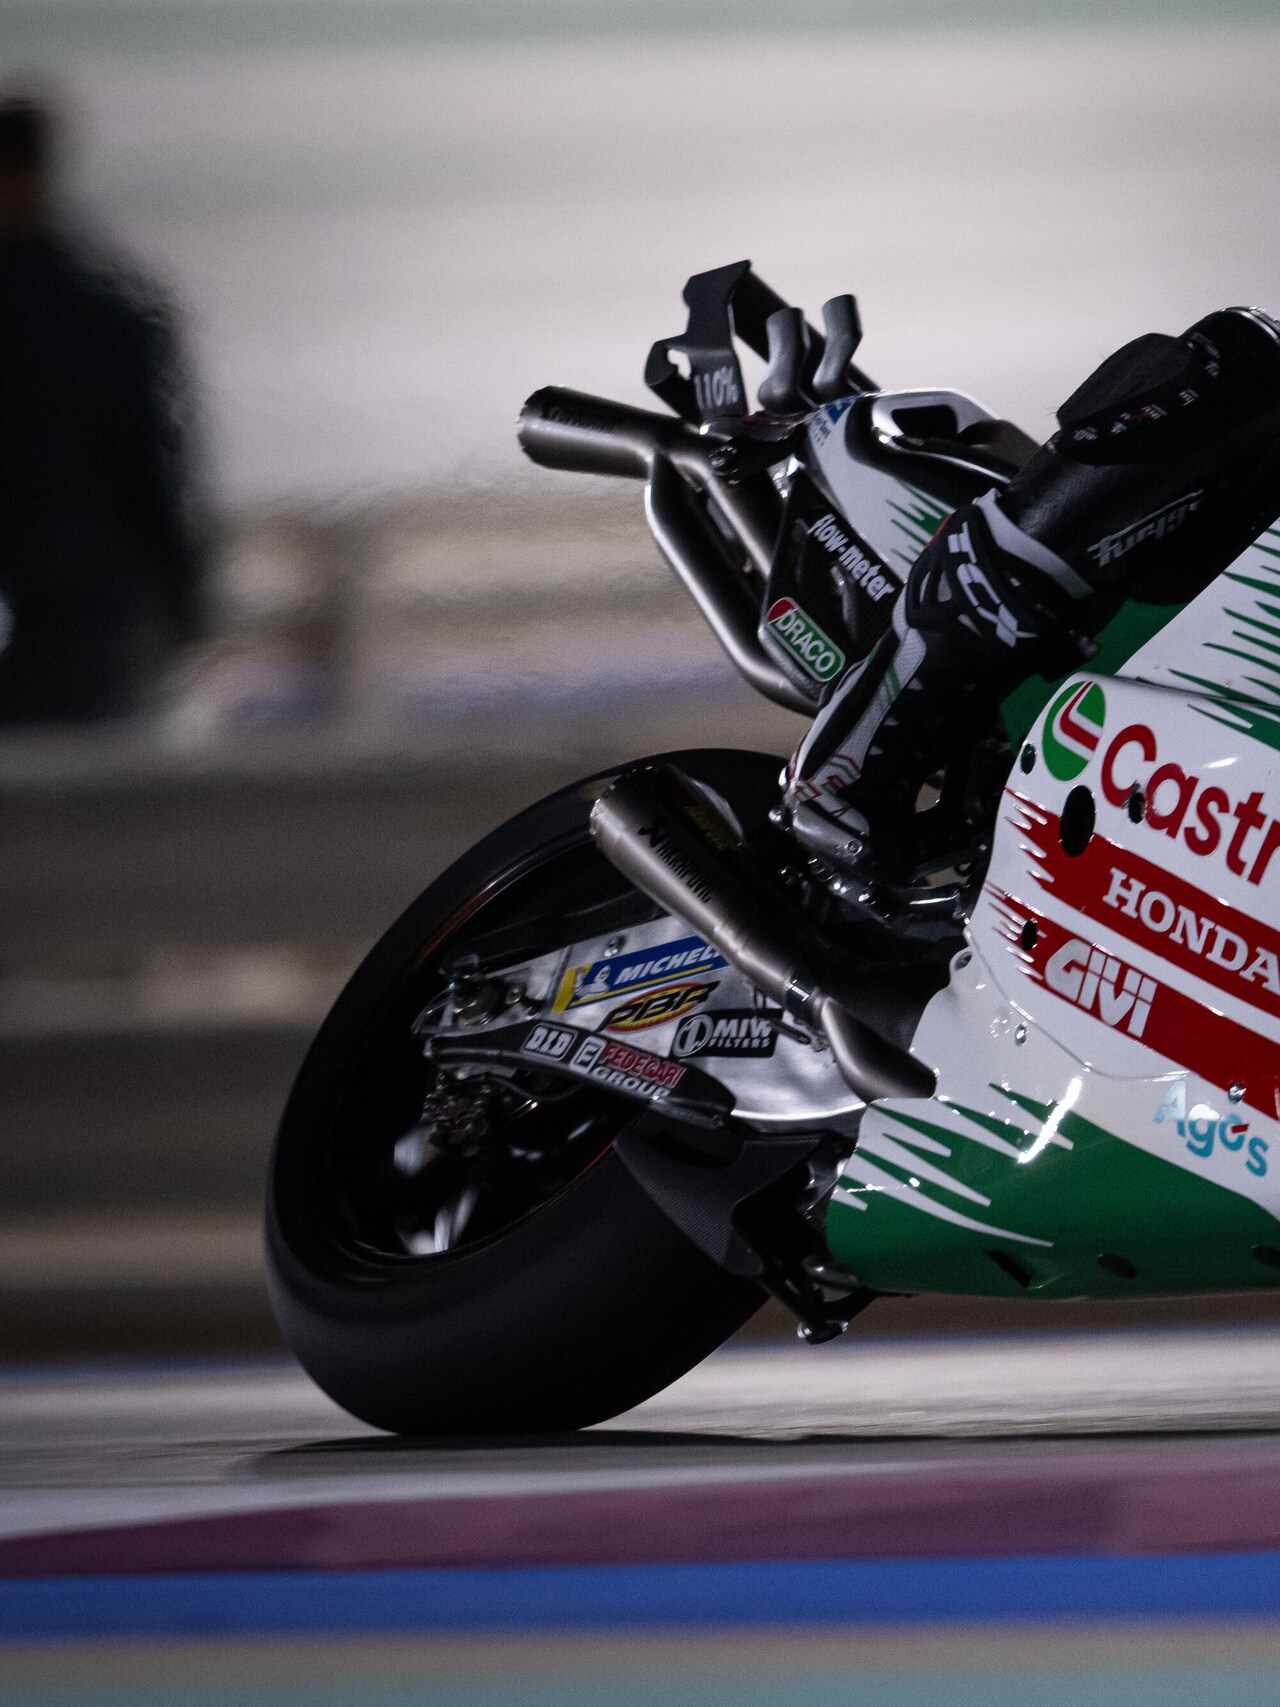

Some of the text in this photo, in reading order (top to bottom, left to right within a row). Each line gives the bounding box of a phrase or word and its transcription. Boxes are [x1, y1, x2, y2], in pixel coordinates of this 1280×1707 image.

[694, 366, 740, 409] 110%
[807, 513, 897, 602] flow-meter
[947, 521, 1040, 649] TCX
[774, 611, 837, 674] DRACO
[614, 945, 722, 986] MICHEL
[1043, 936, 1158, 1038] GIVI
[709, 1036, 771, 1049] FILTERS
[714, 1014, 774, 1039] MIW
[591, 1065, 672, 1098] GROUP
[1153, 1079, 1269, 1178] Agos
